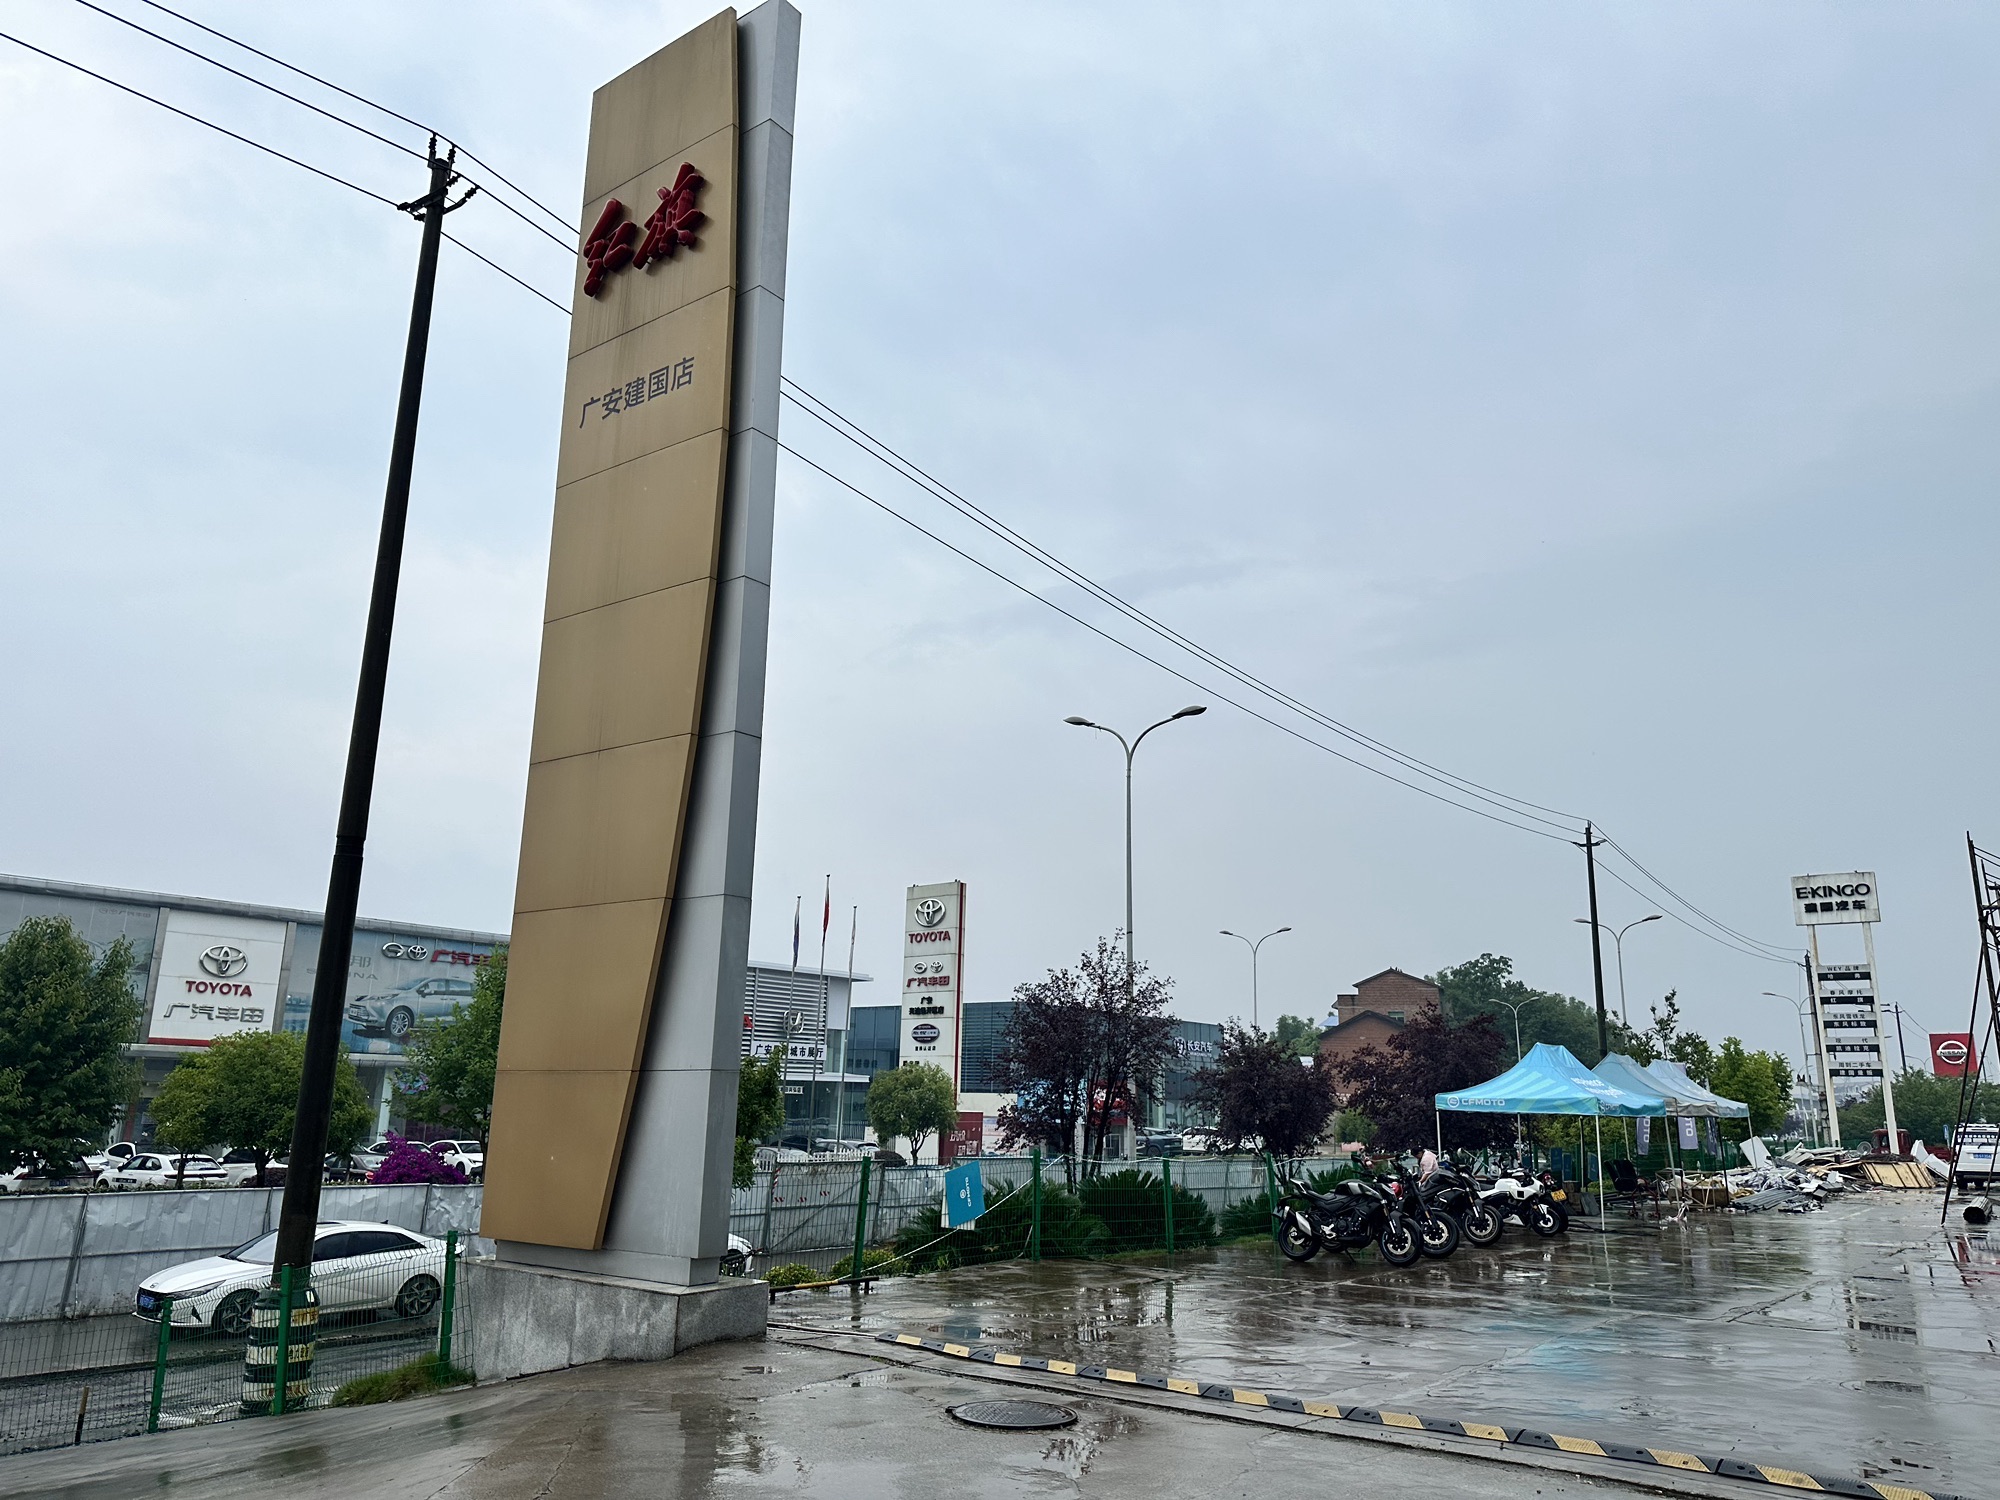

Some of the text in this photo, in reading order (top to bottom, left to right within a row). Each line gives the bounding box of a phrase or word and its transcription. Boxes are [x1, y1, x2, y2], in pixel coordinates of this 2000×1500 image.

[579, 356, 695, 429] 广安建国店
[908, 930, 951, 944] TOYOTA
[186, 981, 252, 997] TOYOTA
[906, 975, 950, 988] 广汽丰田
[163, 1003, 264, 1023] 广汽丰田
[1187, 1040, 1213, 1052] 长安汽车
[1461, 1098, 1506, 1106] CFMOTO
[964, 1176, 972, 1207] CFMOTO
